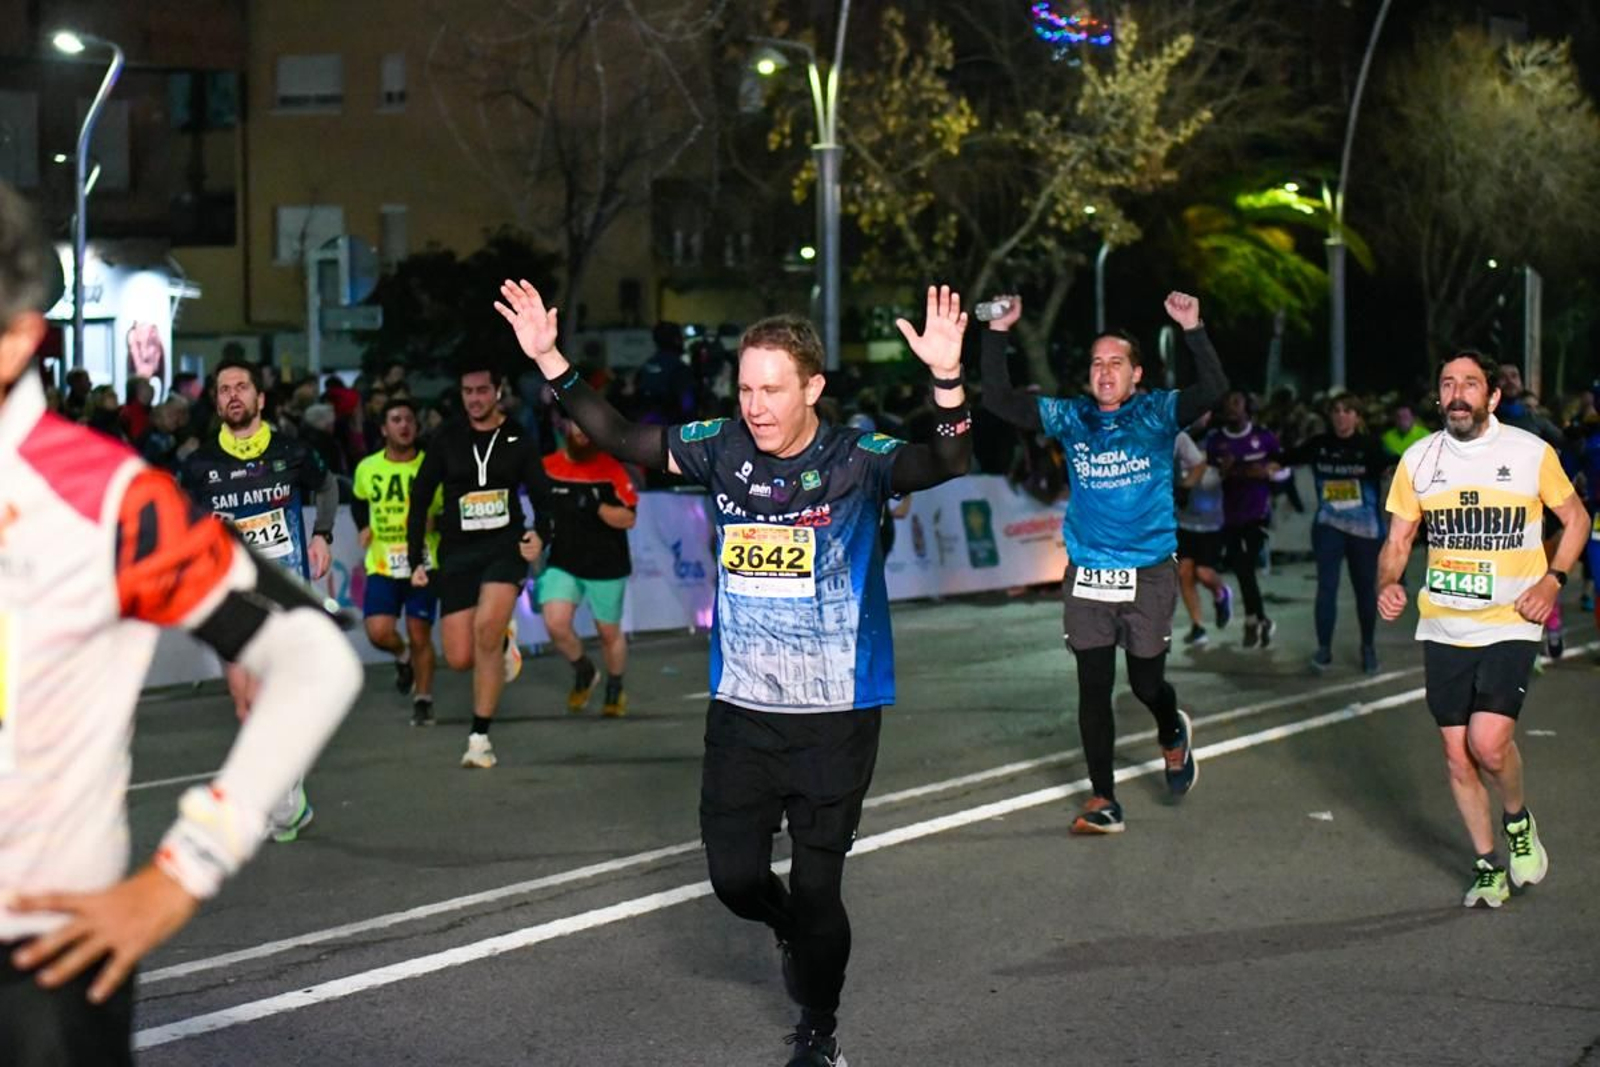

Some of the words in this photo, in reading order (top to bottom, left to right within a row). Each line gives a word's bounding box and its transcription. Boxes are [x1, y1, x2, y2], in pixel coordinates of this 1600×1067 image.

[1090, 449, 1128, 465] MEDIA
[1091, 455, 1150, 478] MARATÓN
[212, 493, 239, 510] SAN
[243, 482, 291, 506] ANTÓN
[1460, 490, 1479, 506] 59
[1423, 507, 1526, 535] BEHOBIA
[241, 523, 284, 545] 212
[1447, 533, 1525, 551] SEBASTIAN
[728, 545, 805, 569] 3642
[1083, 567, 1130, 585] 9139
[1431, 571, 1488, 595] 2148
